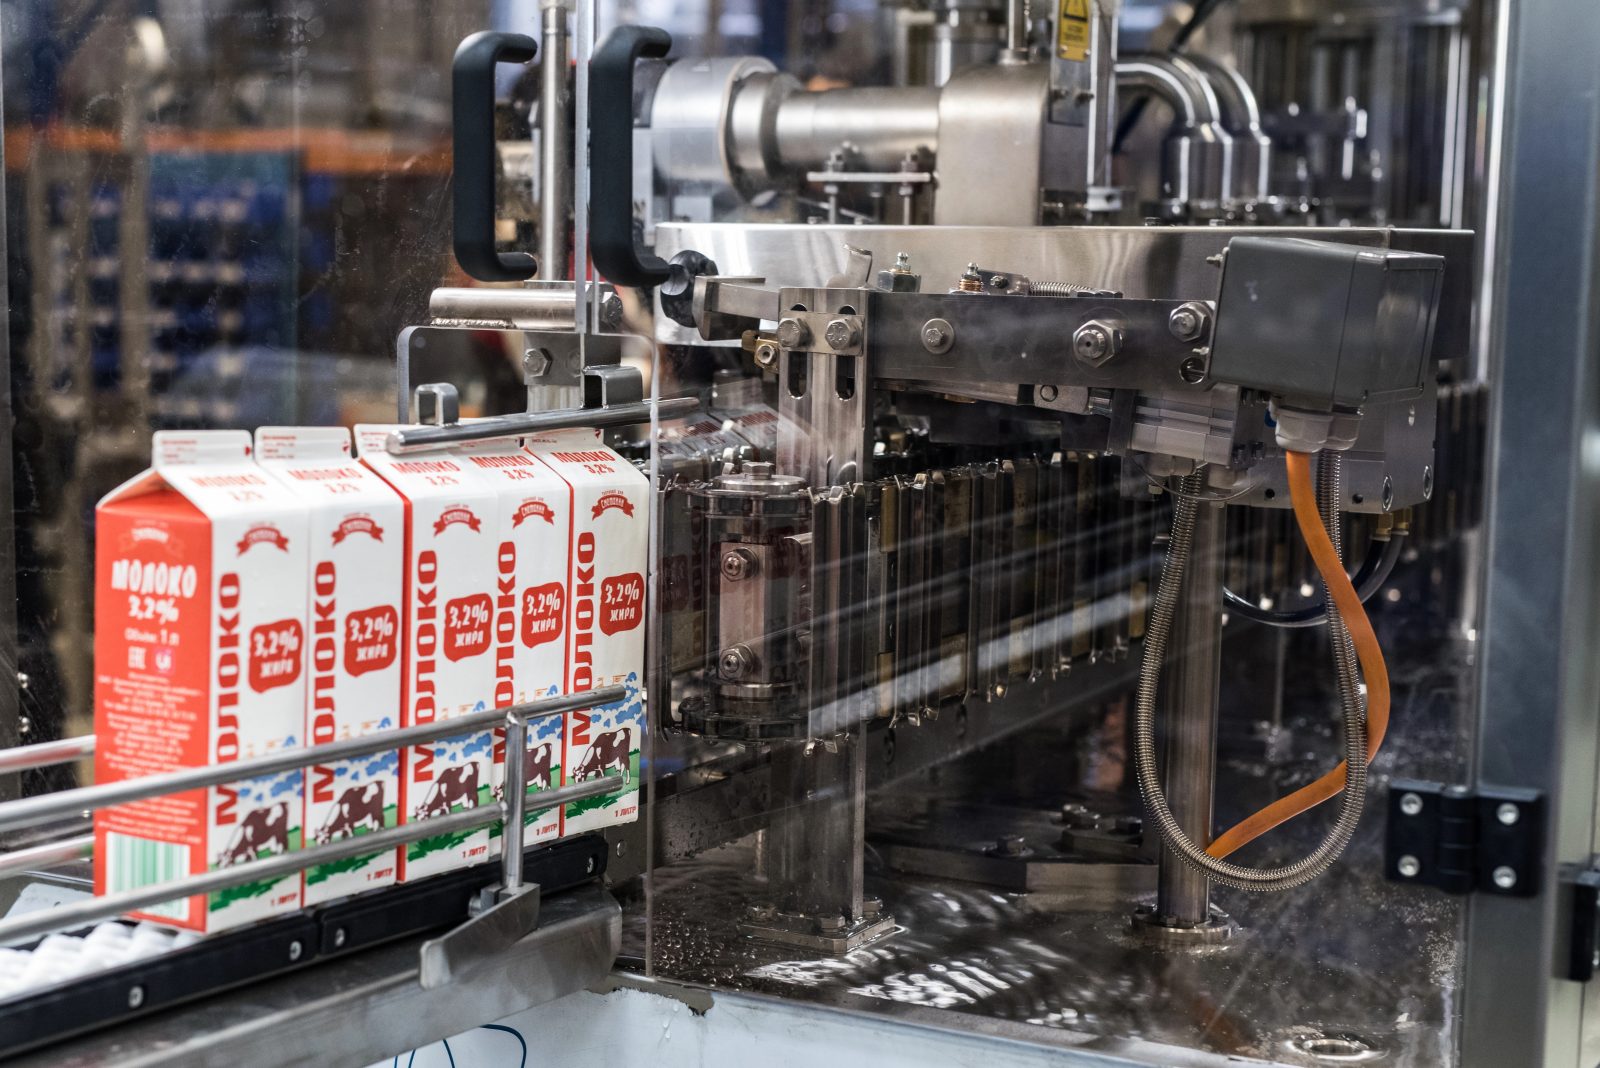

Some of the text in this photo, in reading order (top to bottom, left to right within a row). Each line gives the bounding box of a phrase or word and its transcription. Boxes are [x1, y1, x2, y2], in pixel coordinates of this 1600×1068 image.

[391, 461, 461, 473] МОЛОКО
[469, 455, 534, 468] МОЛОКО
[550, 451, 616, 463] МОЛОКО
[503, 468, 534, 480] 3,2%
[583, 463, 615, 475] 3,2%
[112, 559, 197, 598] МОЛОКО
[526, 588, 561, 616] 3,2%
[604, 579, 640, 606] 3,2%
[128, 595, 179, 624] 3,2%
[449, 600, 488, 629] 3,2%
[609, 606, 635, 622] ЖИРА
[350, 612, 393, 643] 3,2%
[531, 618, 556, 634] ЖИРА
[254, 626, 299, 658] 3,2%
[455, 631, 484, 648] ЖИРА
[572, 531, 595, 746] МОЛОКО
[356, 644, 389, 662] ЖИРА
[494, 541, 516, 764] МОЛОКО
[260, 658, 294, 678] ЖИРА
[414, 550, 437, 783] МОЛОКО
[313, 561, 336, 803] МОЛОКО
[216, 573, 240, 826] МОЛОКО
[619, 805, 637, 817] ЛИТР
[541, 823, 558, 835] ЛИТР
[468, 845, 487, 857] ЛИТР
